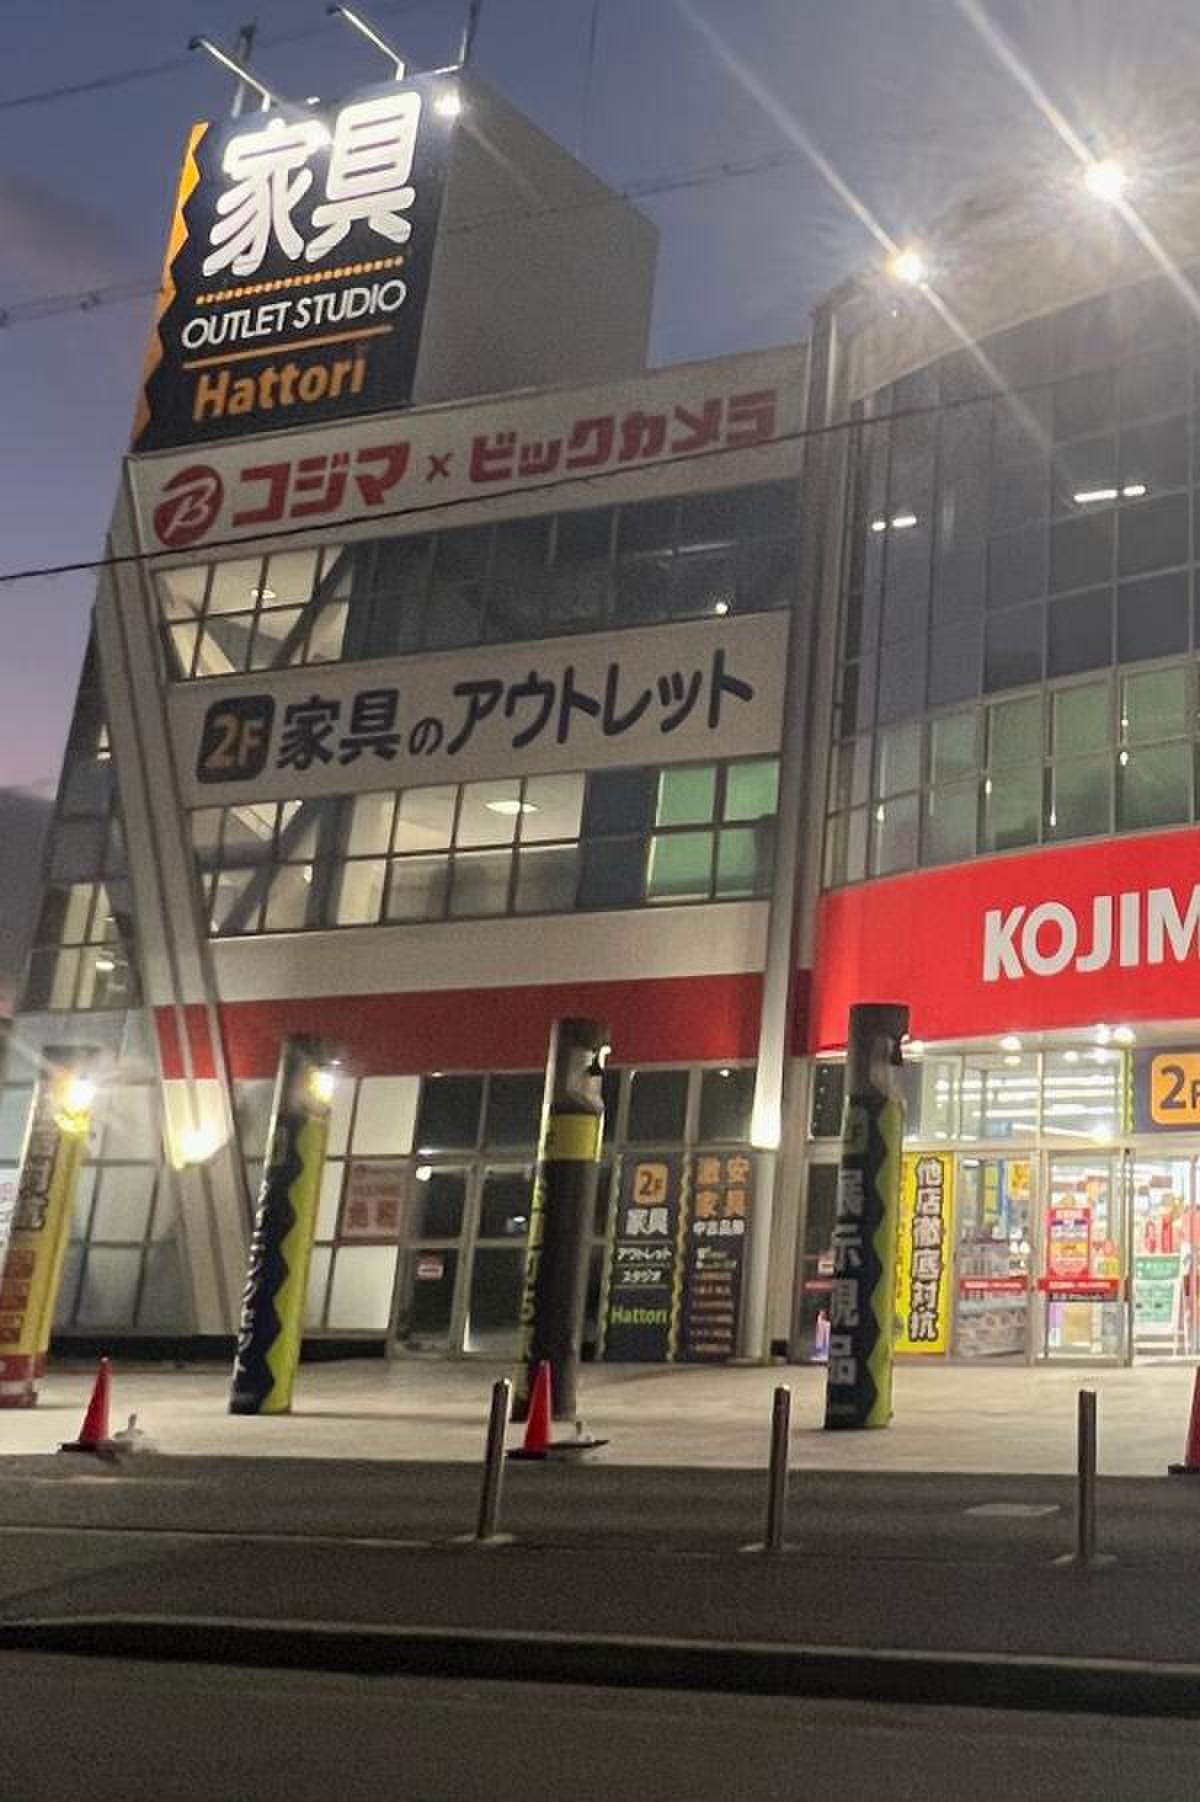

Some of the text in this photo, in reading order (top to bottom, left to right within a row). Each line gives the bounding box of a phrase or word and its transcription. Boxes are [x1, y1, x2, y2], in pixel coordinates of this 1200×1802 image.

[202, 91, 422, 277] 家具
[182, 279, 407, 350] OUTLET STUDIO
[192, 350, 366, 422] Hattori
[231, 441, 411, 528] コジマ
[468, 387, 778, 483] ビックカメラ
[210, 648, 754, 772] 2F 家具のアウトレット
[609, 1303, 668, 1325] Hattori
